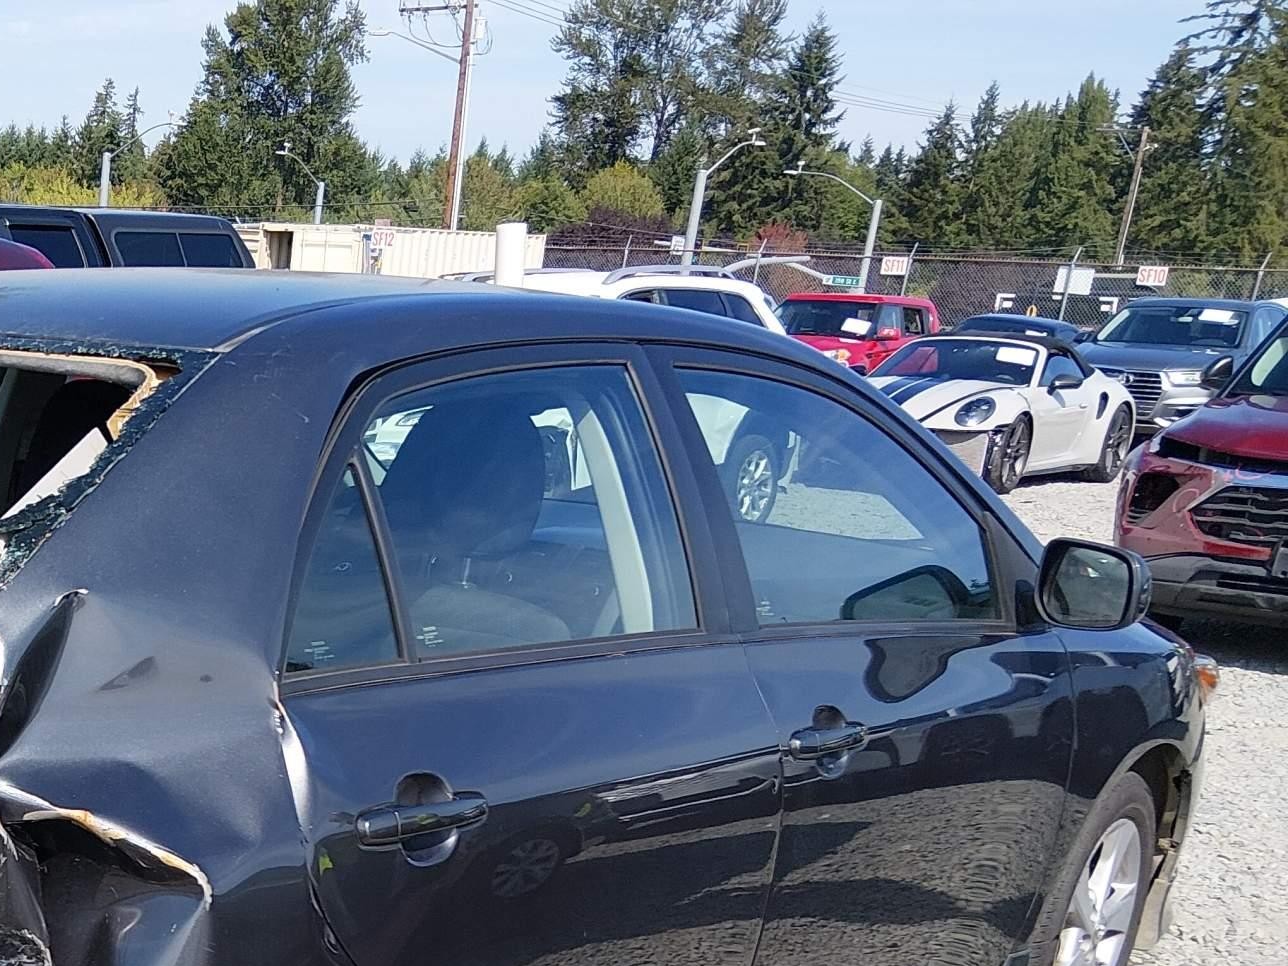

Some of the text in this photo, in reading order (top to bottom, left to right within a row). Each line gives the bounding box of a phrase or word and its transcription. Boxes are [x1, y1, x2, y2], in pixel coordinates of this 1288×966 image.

[372, 231, 395, 247] SF12
[883, 259, 905, 273] SF11
[1138, 267, 1167, 284] SF10
